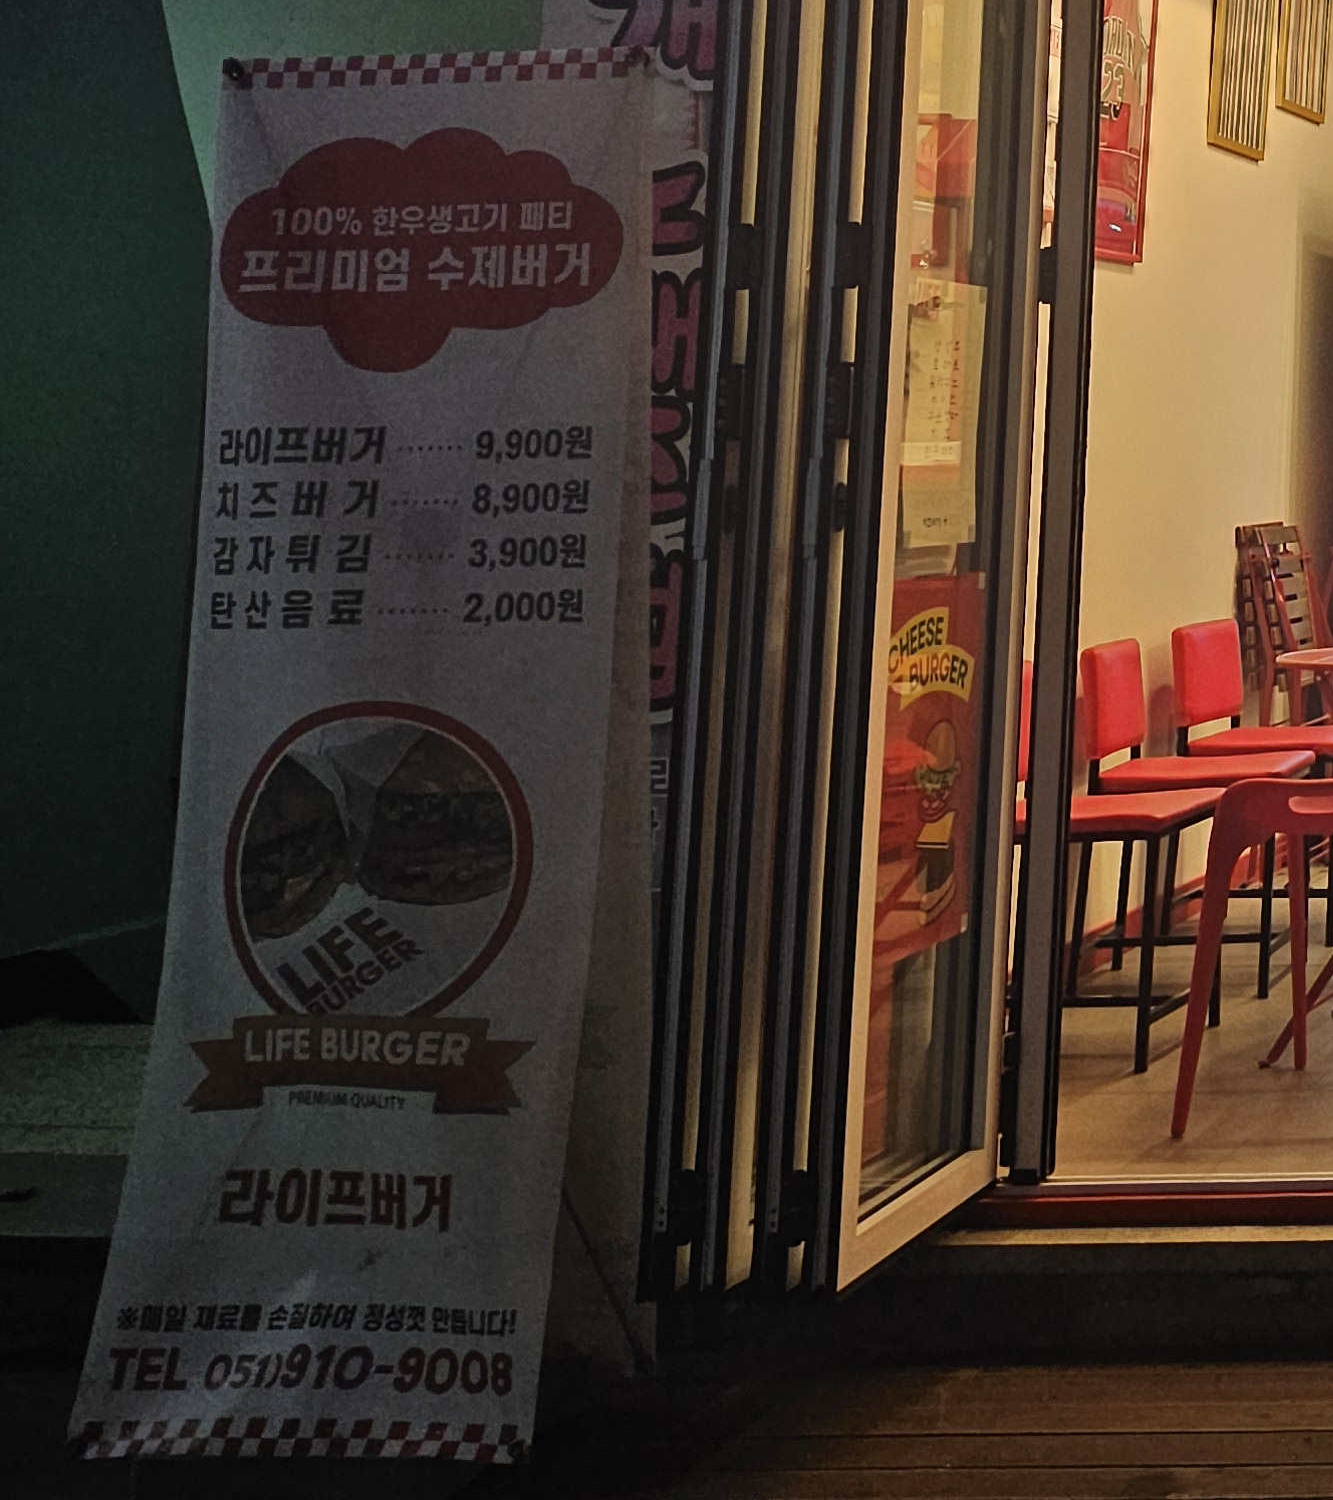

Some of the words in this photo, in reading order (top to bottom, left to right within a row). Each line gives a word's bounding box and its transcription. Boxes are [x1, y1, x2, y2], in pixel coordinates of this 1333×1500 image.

[271, 206, 362, 236] 100%
[372, 203, 507, 236] 한우생고기
[520, 201, 573, 231] 패티
[238, 249, 411, 293] 프리미엄
[427, 242, 592, 291] 수제버거
[219, 425, 386, 466] 라이프버거
[475, 425, 592, 463] 9,900원
[471, 479, 590, 518] 8,900원
[467, 533, 587, 573] 3,900원
[463, 588, 583, 627] 2,000원
[888, 616, 944, 675] CHEESE
[909, 653, 968, 691] BURGER
[276, 907, 402, 1007] LIFE
[243, 1028, 311, 1063] LIFE
[320, 1027, 471, 1067] BURGER
[289, 1091, 347, 1106] PREMIUM
[350, 1093, 406, 1110] QUALITY
[219, 1167, 452, 1232] 라이프버거
[194, 1304, 262, 1332] 재료를
[267, 1302, 356, 1332] 손질하여
[110, 1348, 187, 1391] TEL
[204, 1343, 513, 1395] 051)910-9008
